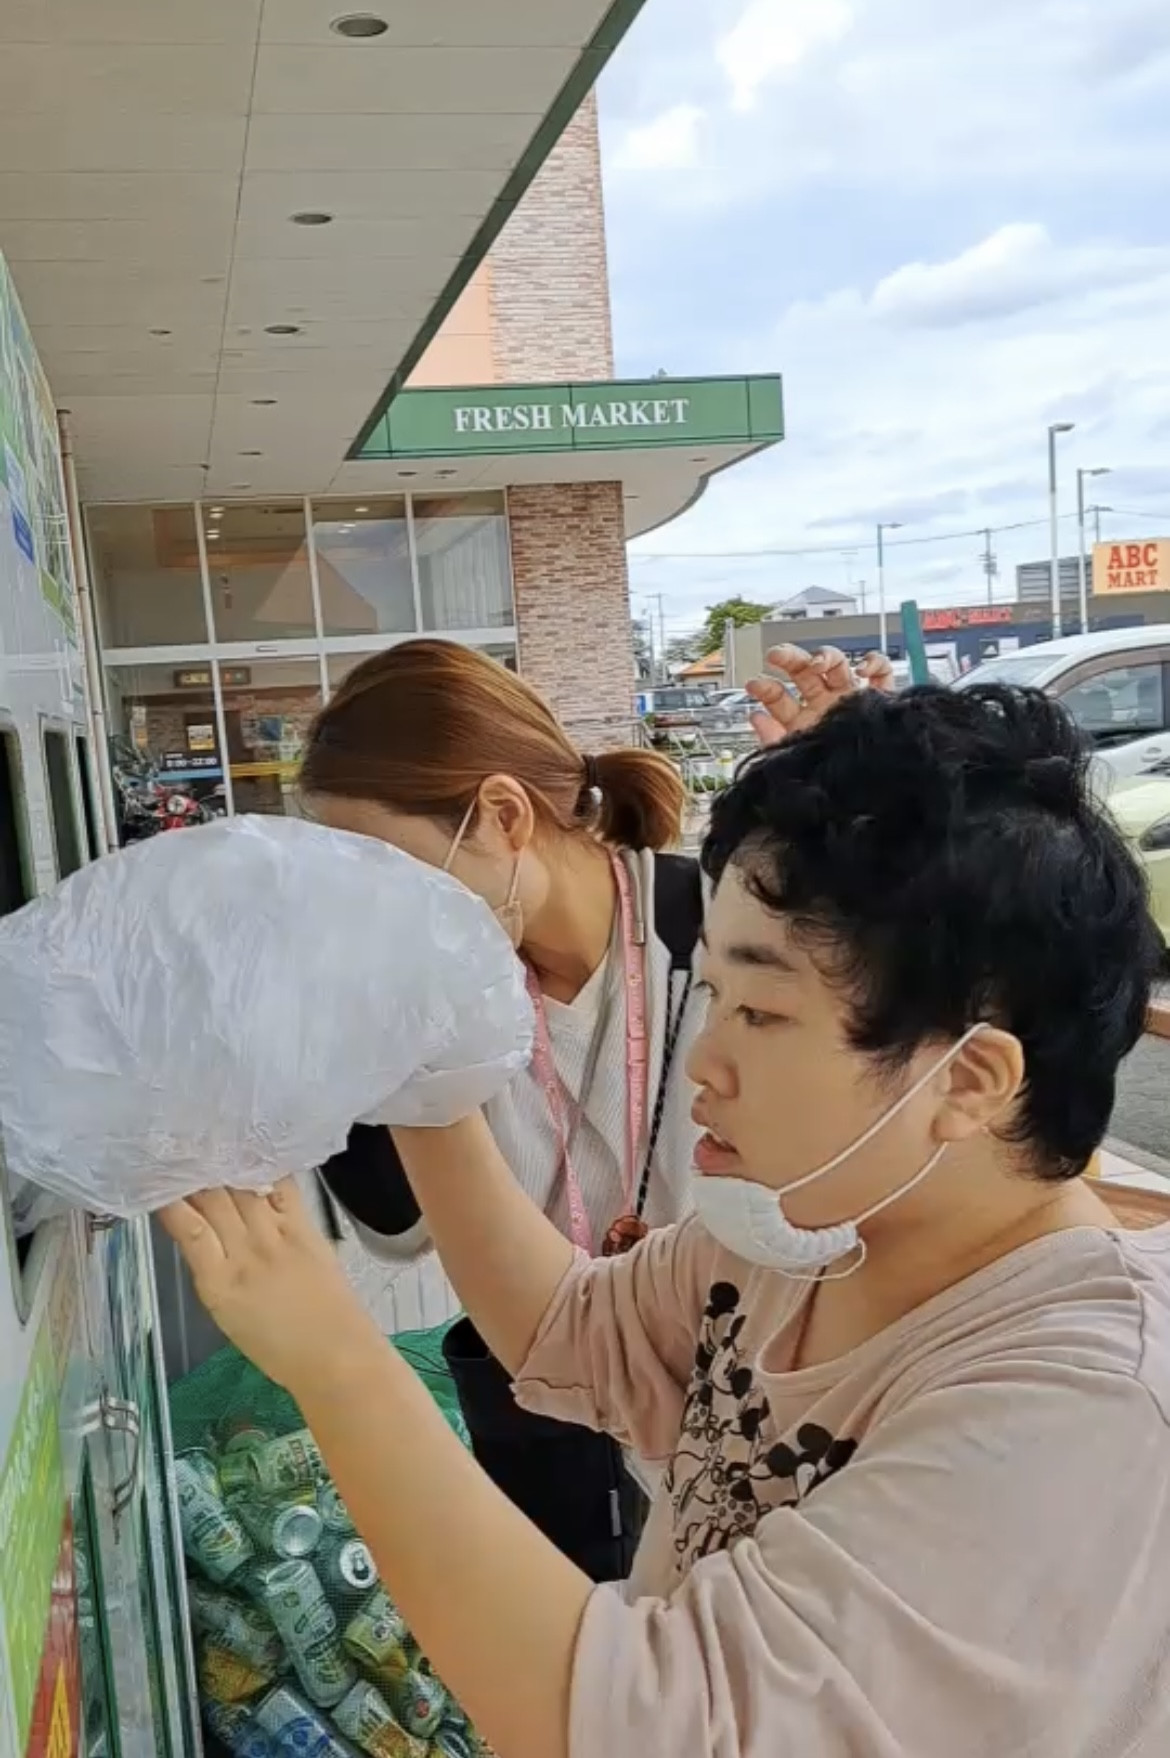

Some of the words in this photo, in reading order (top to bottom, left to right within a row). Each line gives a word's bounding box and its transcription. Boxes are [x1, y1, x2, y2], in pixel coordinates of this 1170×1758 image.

[453, 405, 553, 431] FRESH
[561, 399, 689, 428] MARKET
[1107, 543, 1158, 570] ABC
[1107, 569, 1158, 589] MART
